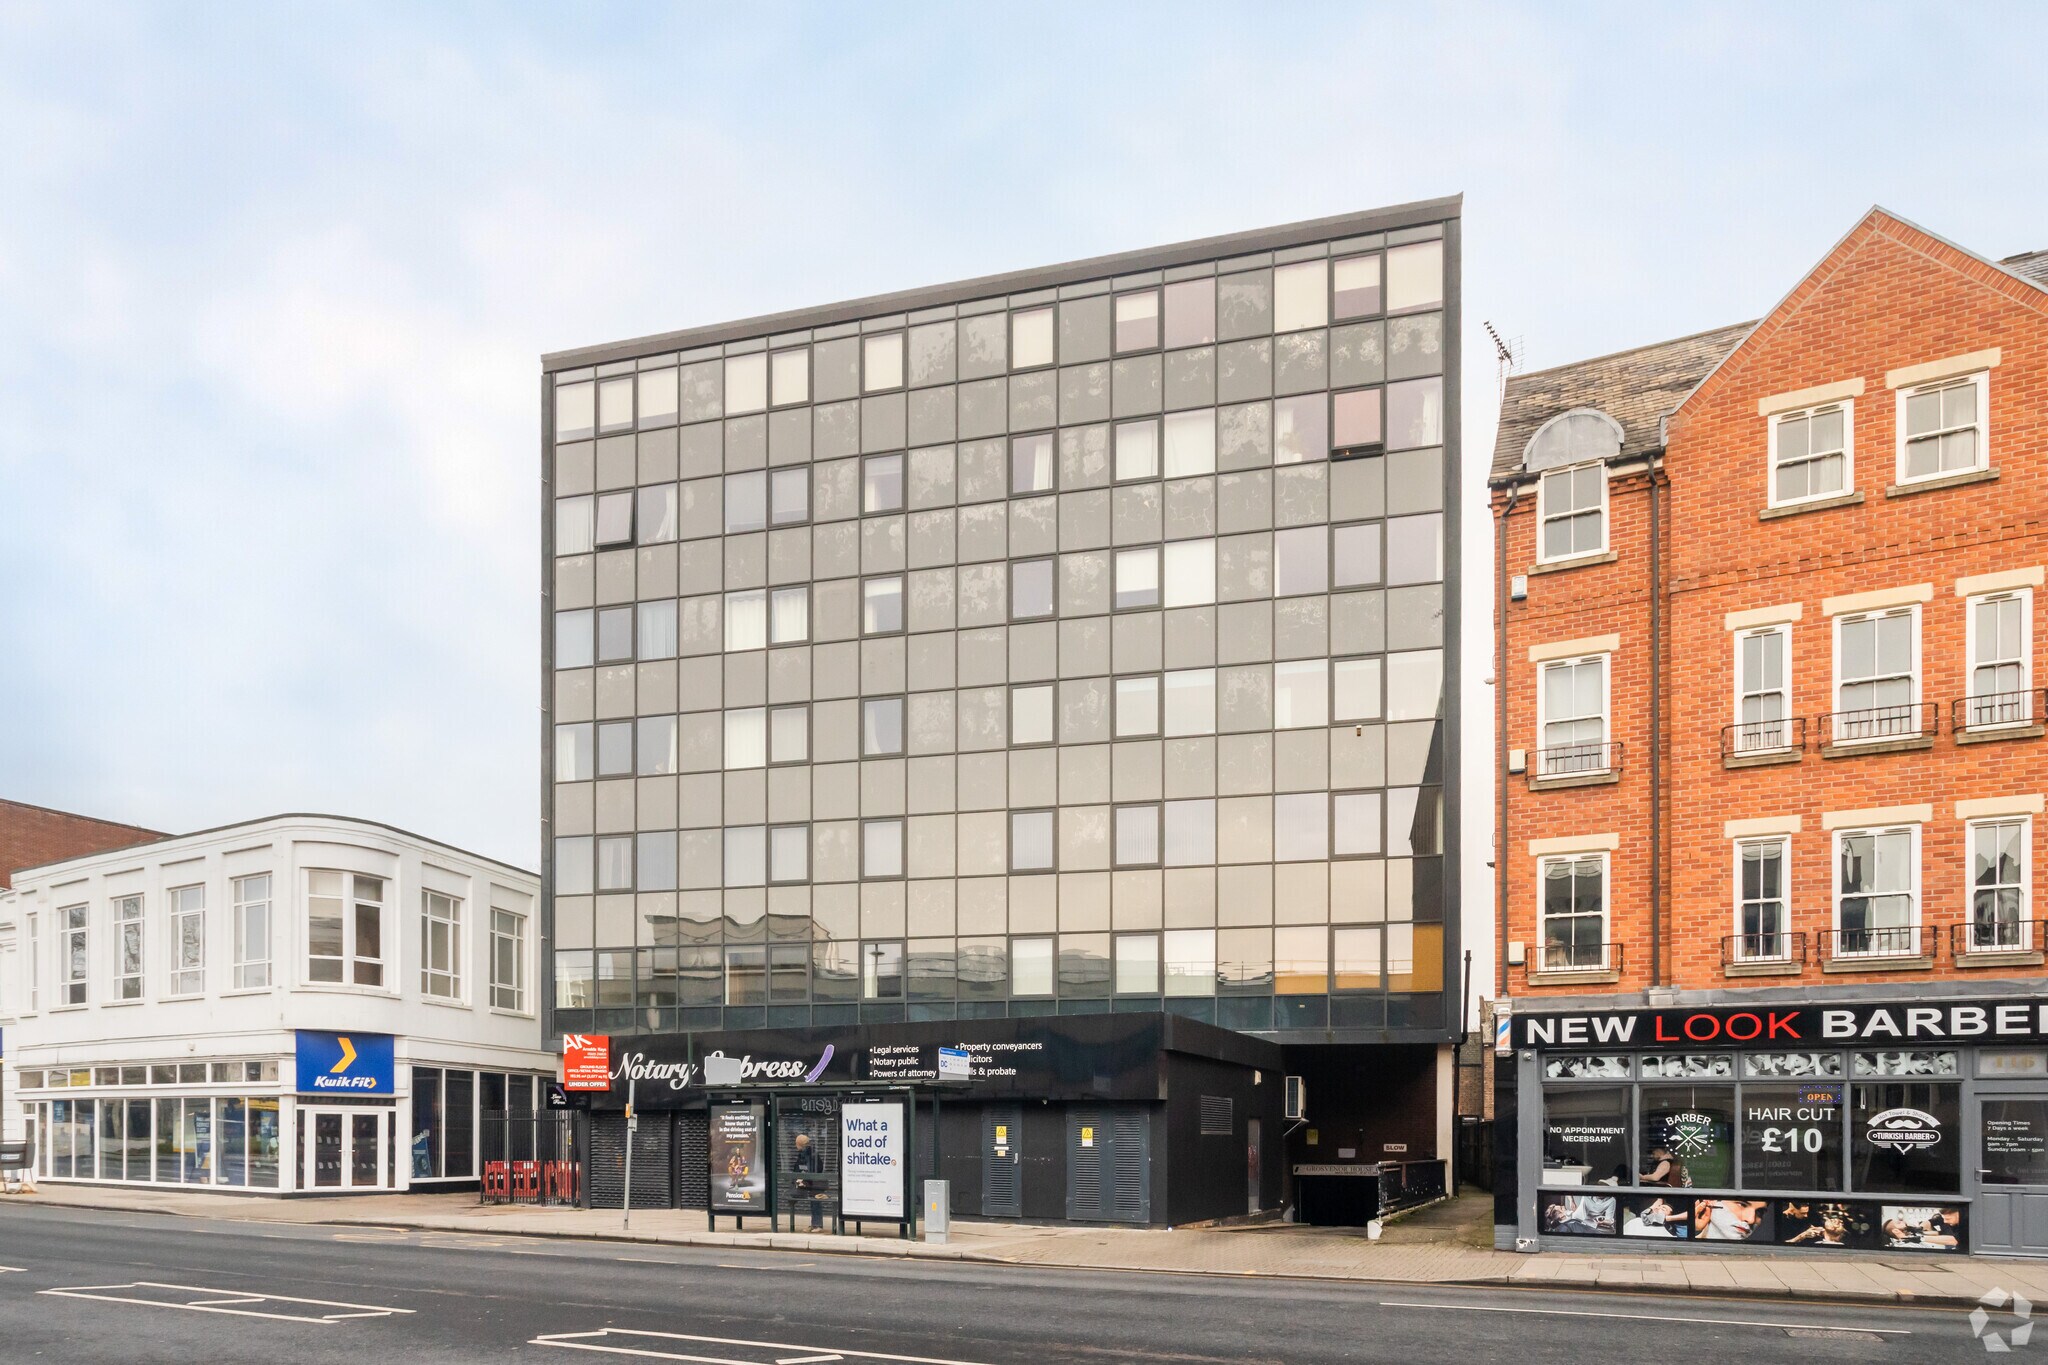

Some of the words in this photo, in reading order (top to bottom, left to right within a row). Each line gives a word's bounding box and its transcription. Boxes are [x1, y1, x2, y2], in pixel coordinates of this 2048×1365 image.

[1527, 1015, 1638, 1044] NEW
[1655, 1011, 1802, 1041] LOOK
[1822, 1005, 2048, 1038] BARBE
[873, 1046, 892, 1055] Legal
[893, 1045, 919, 1053] services
[959, 1042, 991, 1053] Property
[992, 1042, 1043, 1052] conveyancers
[873, 1058, 897, 1067] Notary
[897, 1058, 919, 1066] public
[969, 1055, 993, 1064] licitors
[608, 1052, 699, 1091] Notary
[873, 1069, 897, 1078] Powers
[898, 1069, 907, 1077] of
[907, 1069, 937, 1079] attorney
[978, 1067, 986, 1076] &
[986, 1066, 1017, 1078] probate
[314, 1075, 352, 1088] Kwik
[350, 1076, 371, 1088] Fit
[1807, 1093, 1833, 1101] OPEN
[1665, 1113, 1712, 1126] BARBER
[1748, 1107, 1792, 1121] HAIR
[1797, 1107, 1836, 1121] CUT
[1912, 1111, 1929, 1120] Shave
[846, 1118, 878, 1131] What
[880, 1121, 888, 1131] a
[1549, 1126, 1562, 1134] NO
[1680, 1124, 1697, 1133] Shop
[847, 1135, 872, 1148] load
[874, 1135, 887, 1148] of
[1761, 1127, 1823, 1153] £10
[1876, 1132, 1904, 1140] TURKISH
[1904, 1132, 1931, 1140] BARBER
[847, 1152, 891, 1165] shiitake
